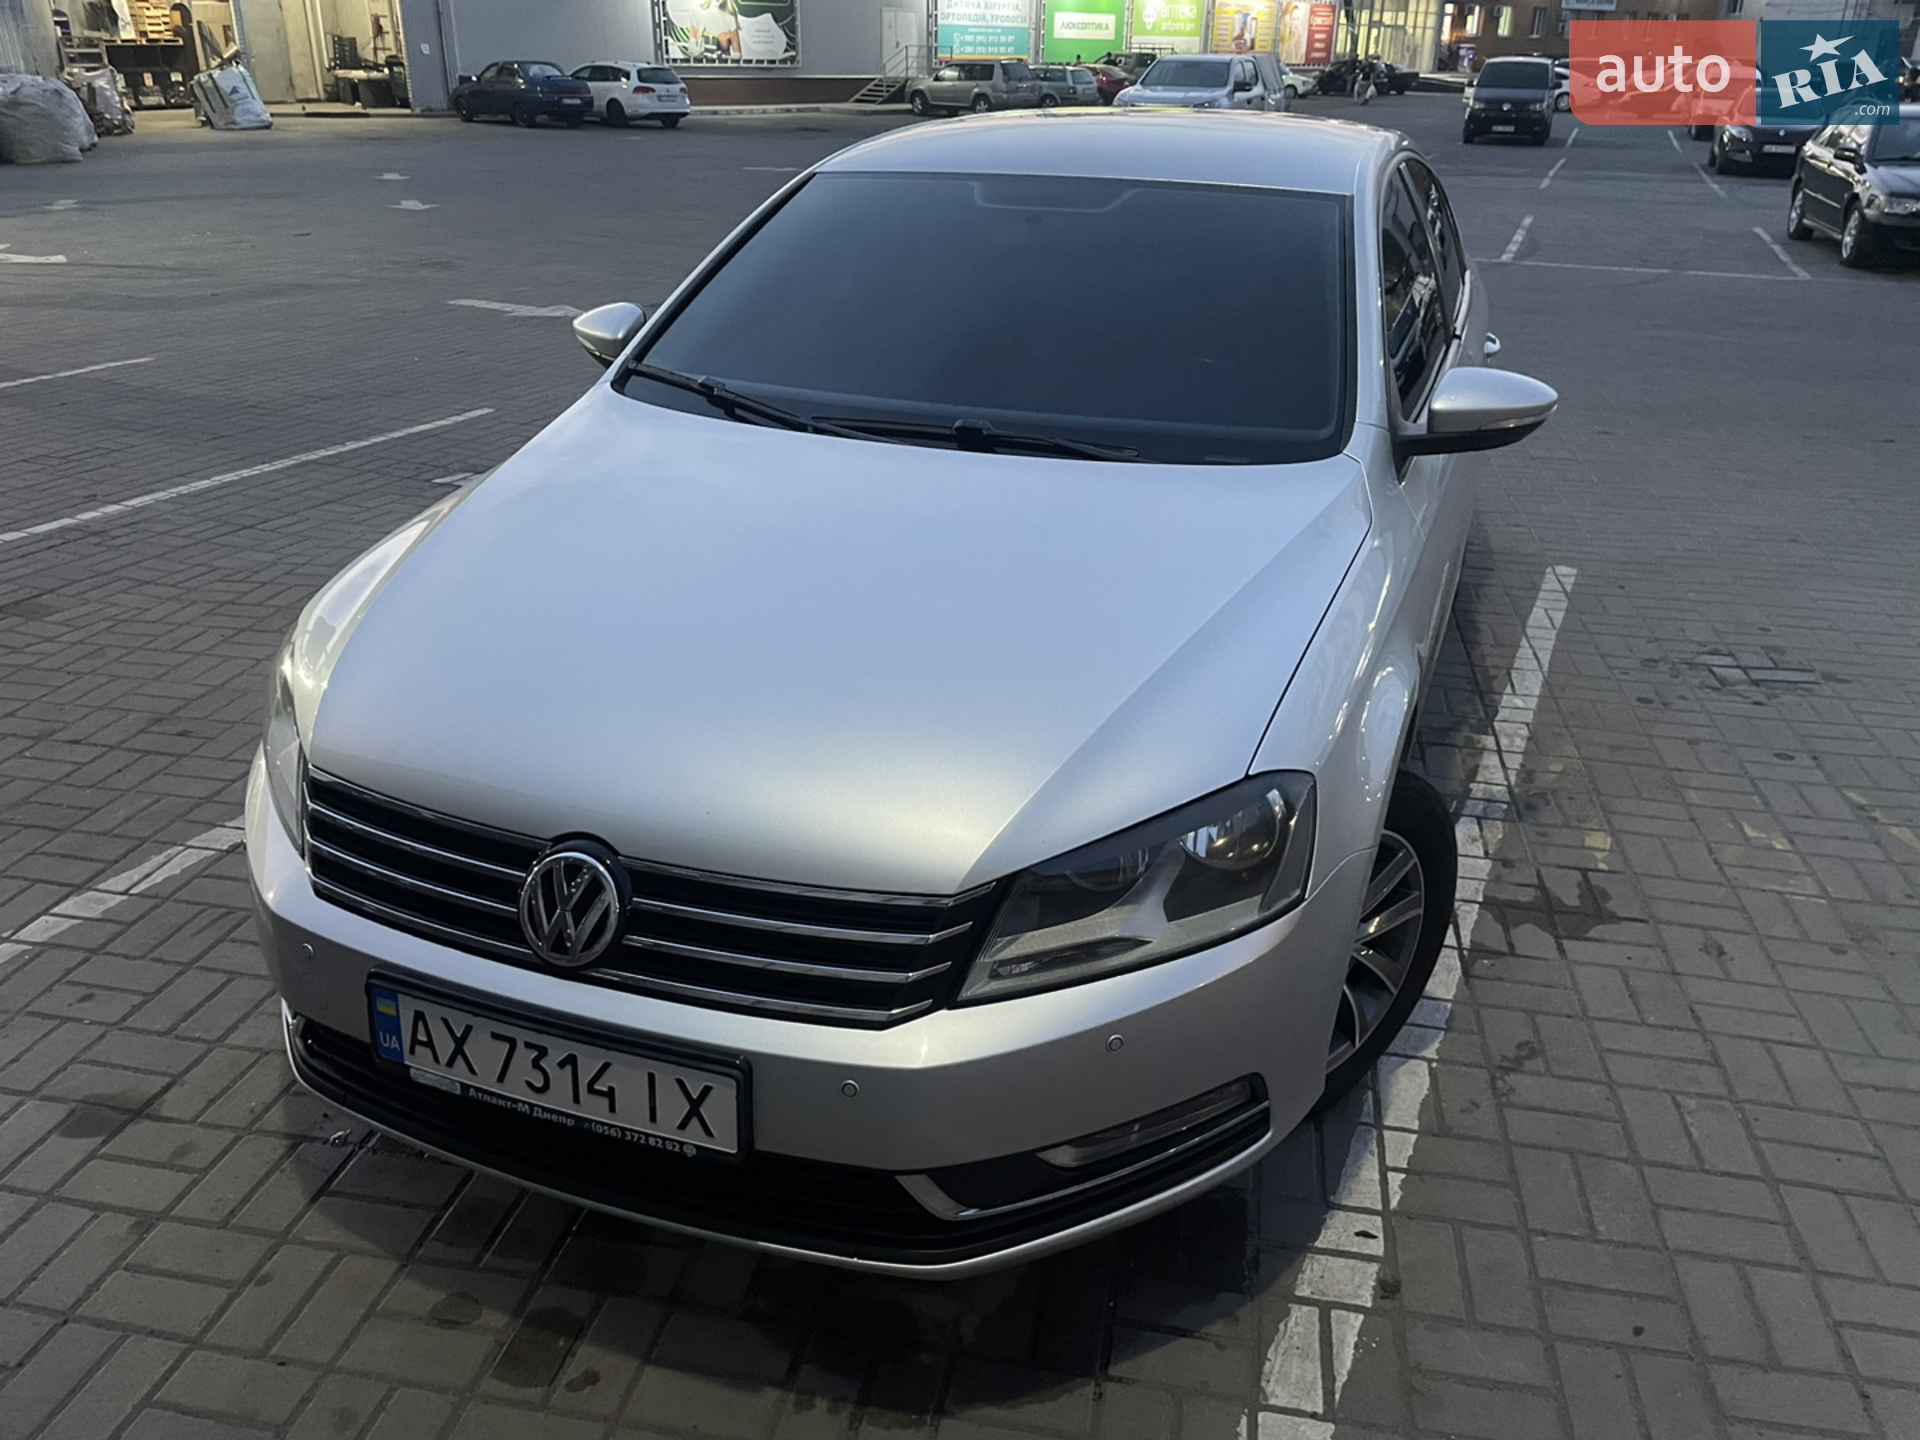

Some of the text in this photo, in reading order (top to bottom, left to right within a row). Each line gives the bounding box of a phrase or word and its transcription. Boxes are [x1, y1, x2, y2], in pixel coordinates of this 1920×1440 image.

[940, 12, 1028, 24] ОРТОПЕДІЯ, УРОЛОГІЯ
[1060, 21, 1110, 31] ЛЮКСОПТИКА
[379, 1030, 400, 1052] UA
[408, 1009, 715, 1138] AX 7314 IX
[468, 1087, 530, 1116] Атлант-М
[532, 1107, 575, 1127] Днепр
[591, 1121, 621, 1139] (056)
[624, 1129, 646, 1145] 372
